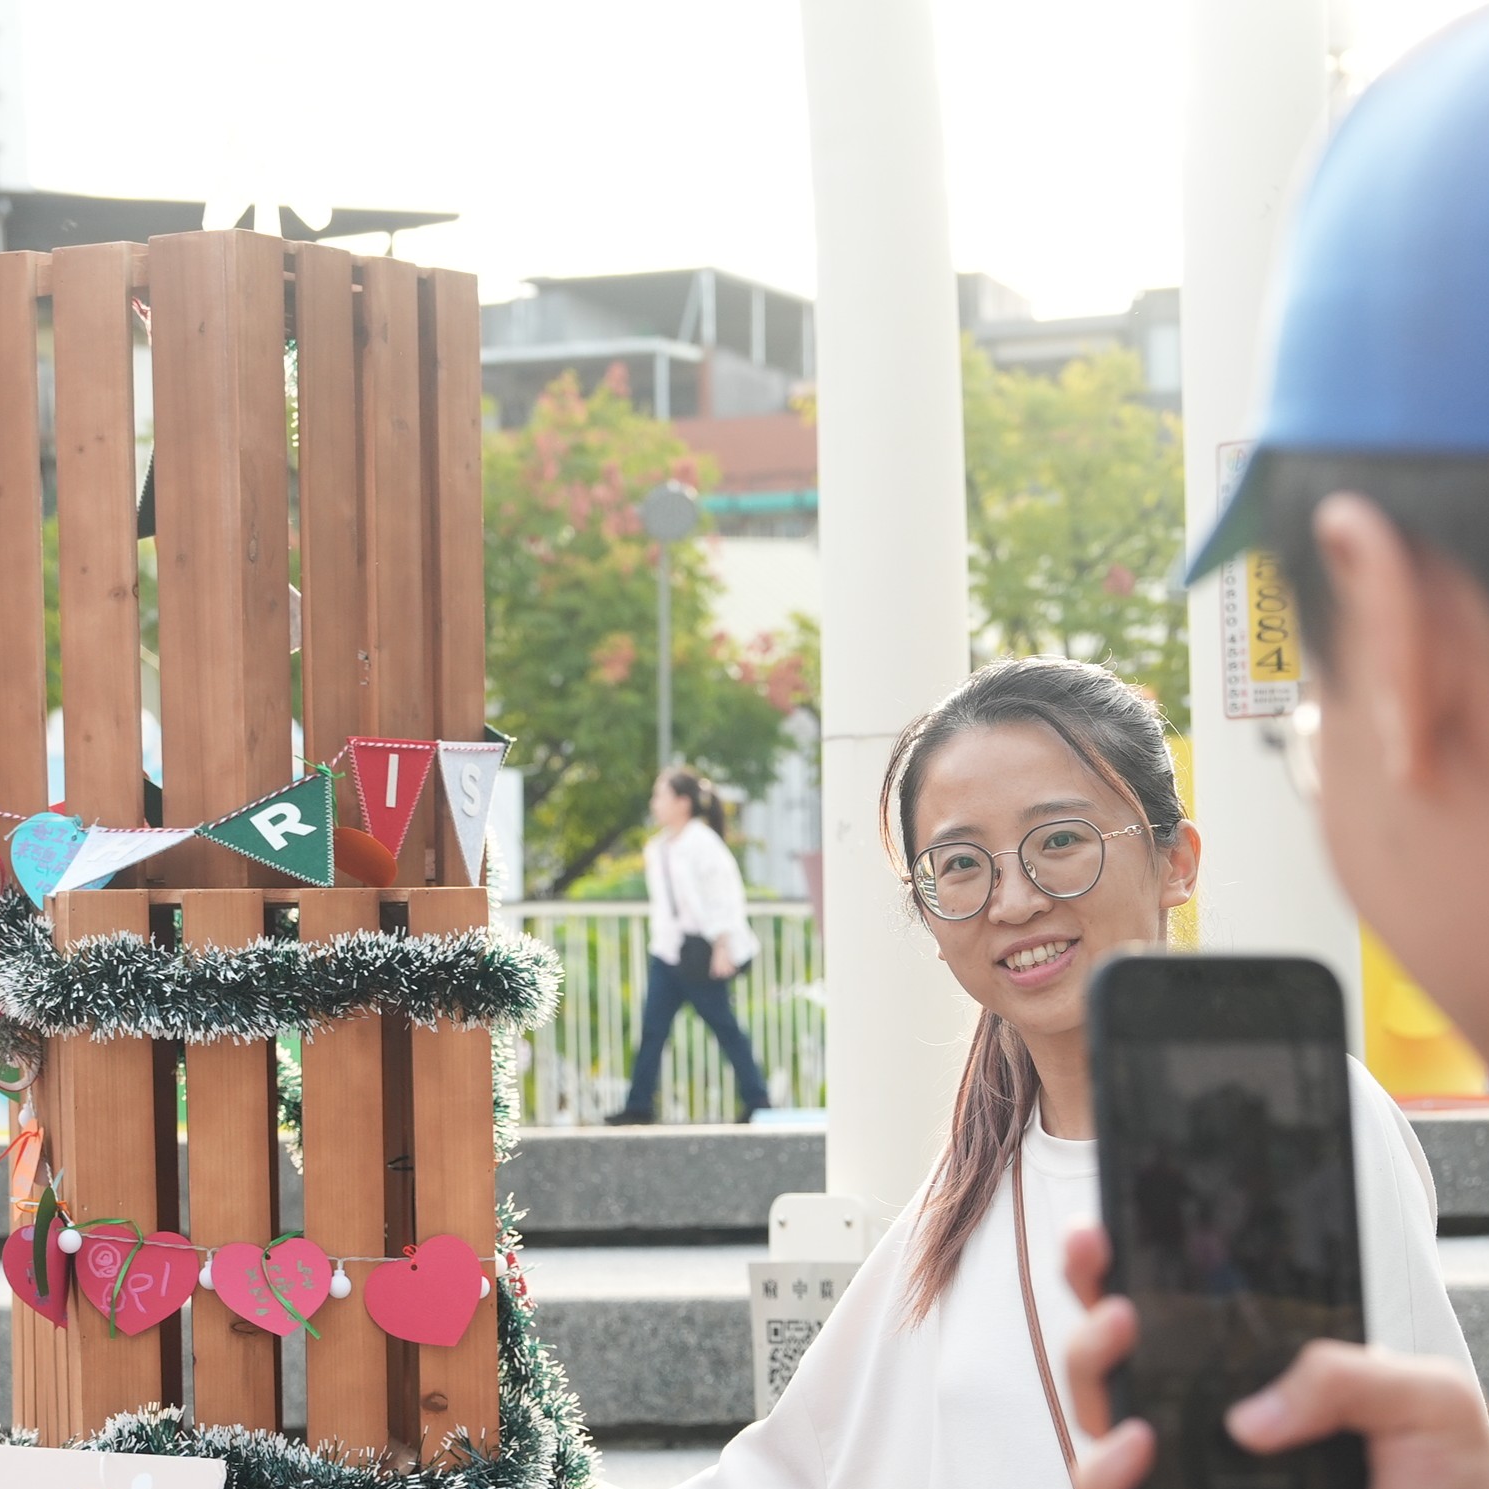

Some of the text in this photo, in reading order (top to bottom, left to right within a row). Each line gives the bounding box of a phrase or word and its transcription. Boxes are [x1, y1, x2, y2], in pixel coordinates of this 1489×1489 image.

[249, 802, 317, 851] R
[385, 754, 399, 808] I
[460, 763, 482, 817] S
